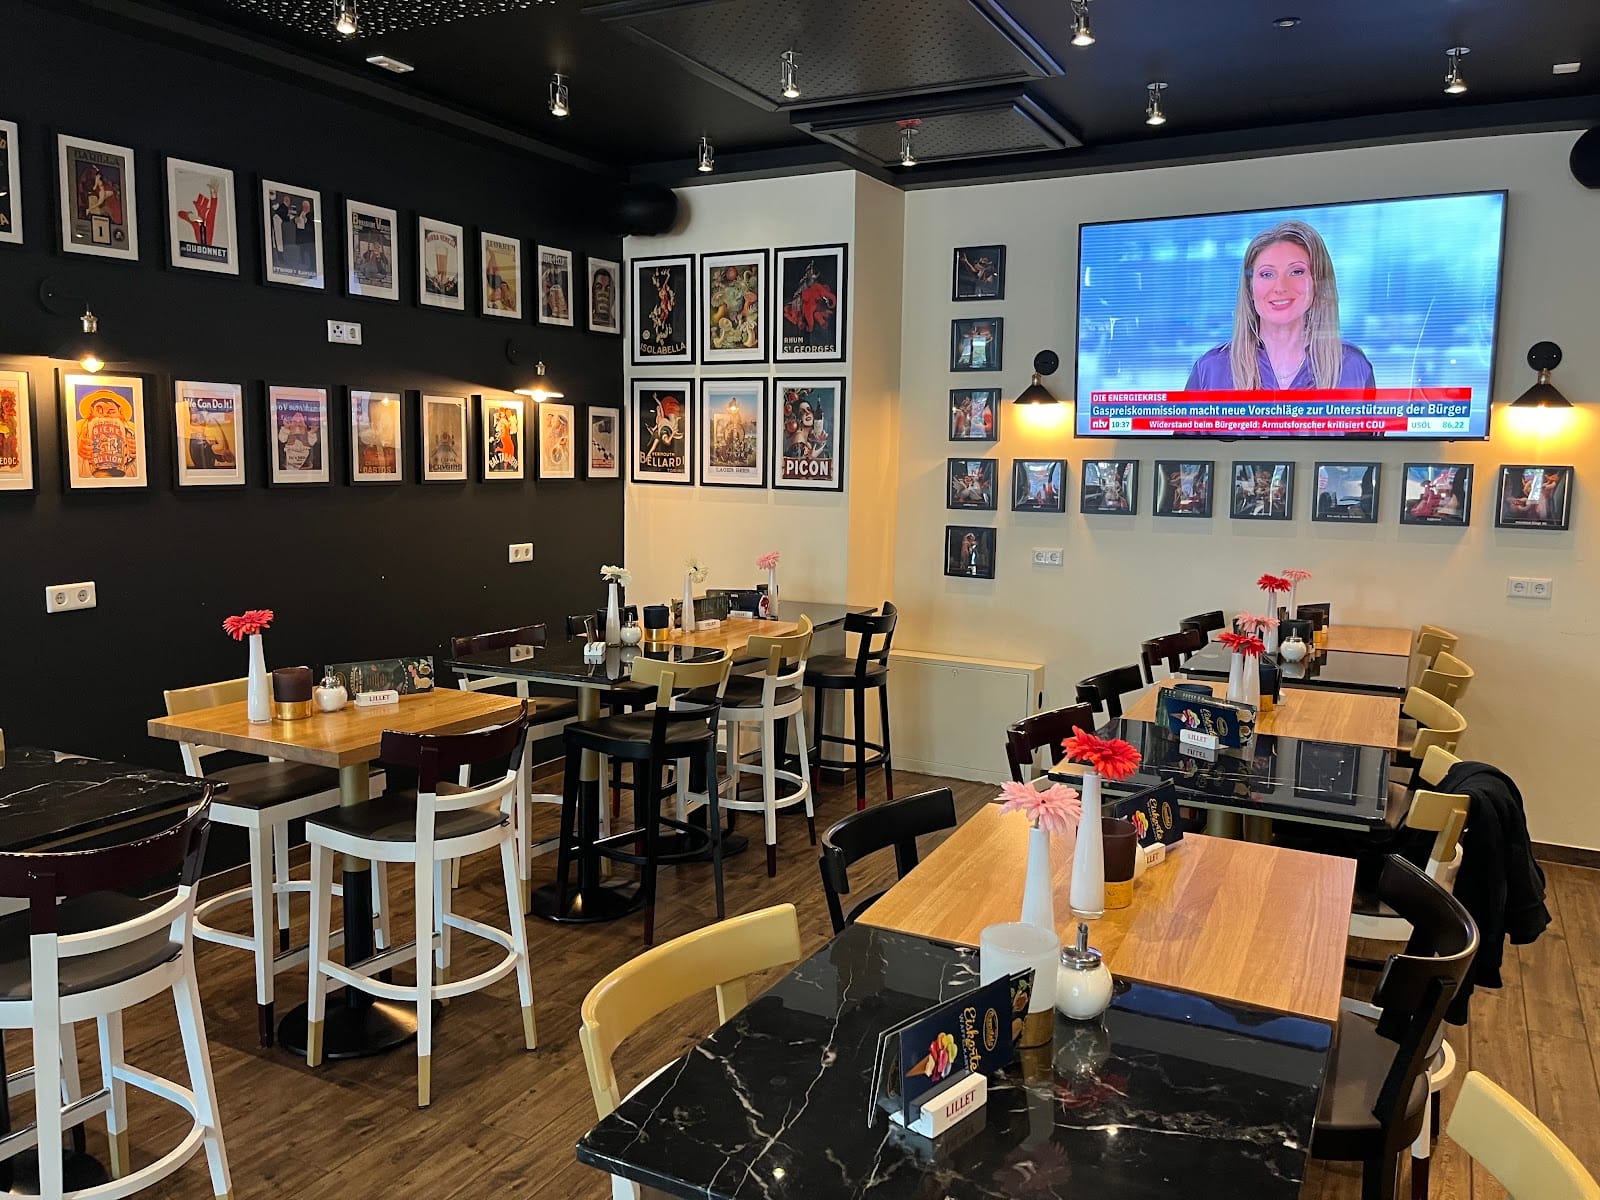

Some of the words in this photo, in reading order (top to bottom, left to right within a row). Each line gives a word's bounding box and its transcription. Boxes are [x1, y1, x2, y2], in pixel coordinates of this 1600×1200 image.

[186, 244, 227, 257] DUBONNET
[783, 336, 804, 344] RHUM
[640, 342, 687, 355] ISOLABELLA
[793, 345, 835, 353] GEORGES
[1092, 393, 1107, 402] DIE
[1108, 392, 1167, 402] ENERGIEKRISE
[183, 397, 197, 408] We
[197, 398, 212, 409] Can
[212, 399, 223, 409] Do
[223, 399, 233, 410] It!
[1092, 404, 1187, 417] Gaspreiskommission
[1189, 404, 1220, 416] macht
[1222, 406, 1246, 416] neue
[1248, 403, 1304, 417] Vorschläge
[1306, 405, 1323, 416] zur
[1325, 403, 1404, 417] Unterstützung
[1405, 403, 1426, 415] der
[1428, 402, 1468, 417] Bürger
[1092, 420, 1108, 429] ntv
[1111, 421, 1130, 429] 10:37
[1149, 420, 1192, 429] Widerstand
[1193, 420, 1213, 429] beim
[1214, 419, 1261, 430] Bürgergeld:
[1261, 420, 1325, 429] Armutsforscher
[1327, 420, 1364, 429] kritisiert
[1365, 420, 1385, 429] CDU
[639, 450, 685, 468] BELLARDI
[786, 458, 829, 477] PICON
[369, 694, 390, 702] LILLET
[1187, 733, 1208, 743] LILLET
[1146, 851, 1160, 864] LLET
[946, 1090, 976, 1118] LILLET
